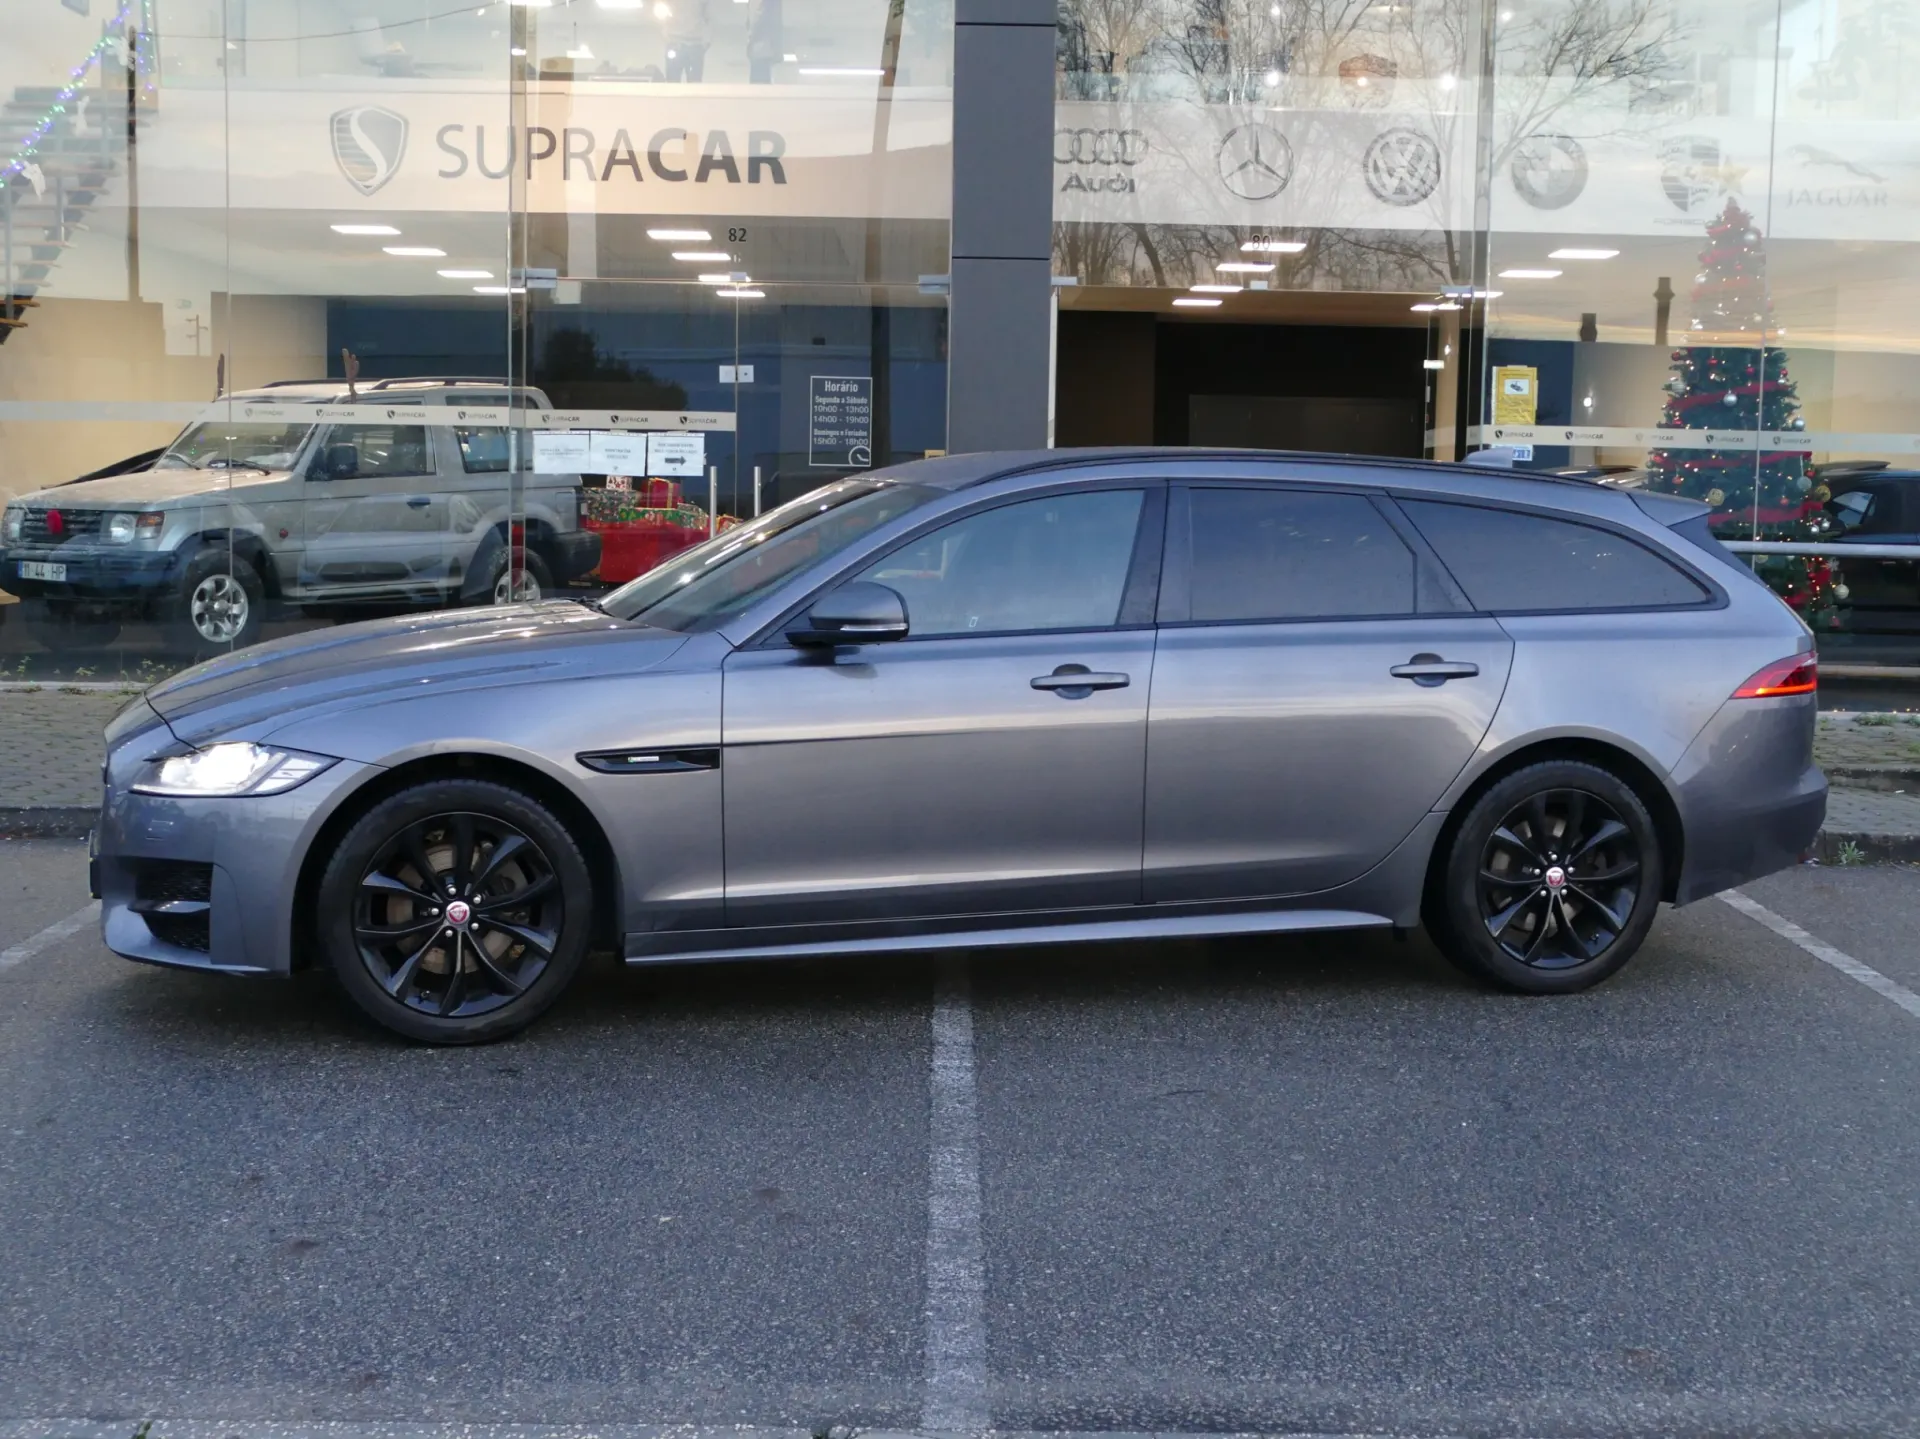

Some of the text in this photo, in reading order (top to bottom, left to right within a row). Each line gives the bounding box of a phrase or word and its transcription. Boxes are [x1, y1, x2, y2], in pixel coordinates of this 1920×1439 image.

[435, 124, 787, 185] SUPRACAR
[1060, 172, 1135, 193] Audi
[1785, 188, 1888, 208] JAGUAR
[728, 228, 747, 242] 82
[1252, 234, 1271, 250] 80
[824, 380, 858, 392] Horário
[815, 395, 840, 404] Segunda
[813, 405, 837, 413] 10h00
[813, 415, 837, 423] 14h00
[845, 416, 869, 424] 19h00
[813, 437, 837, 445] 15h00
